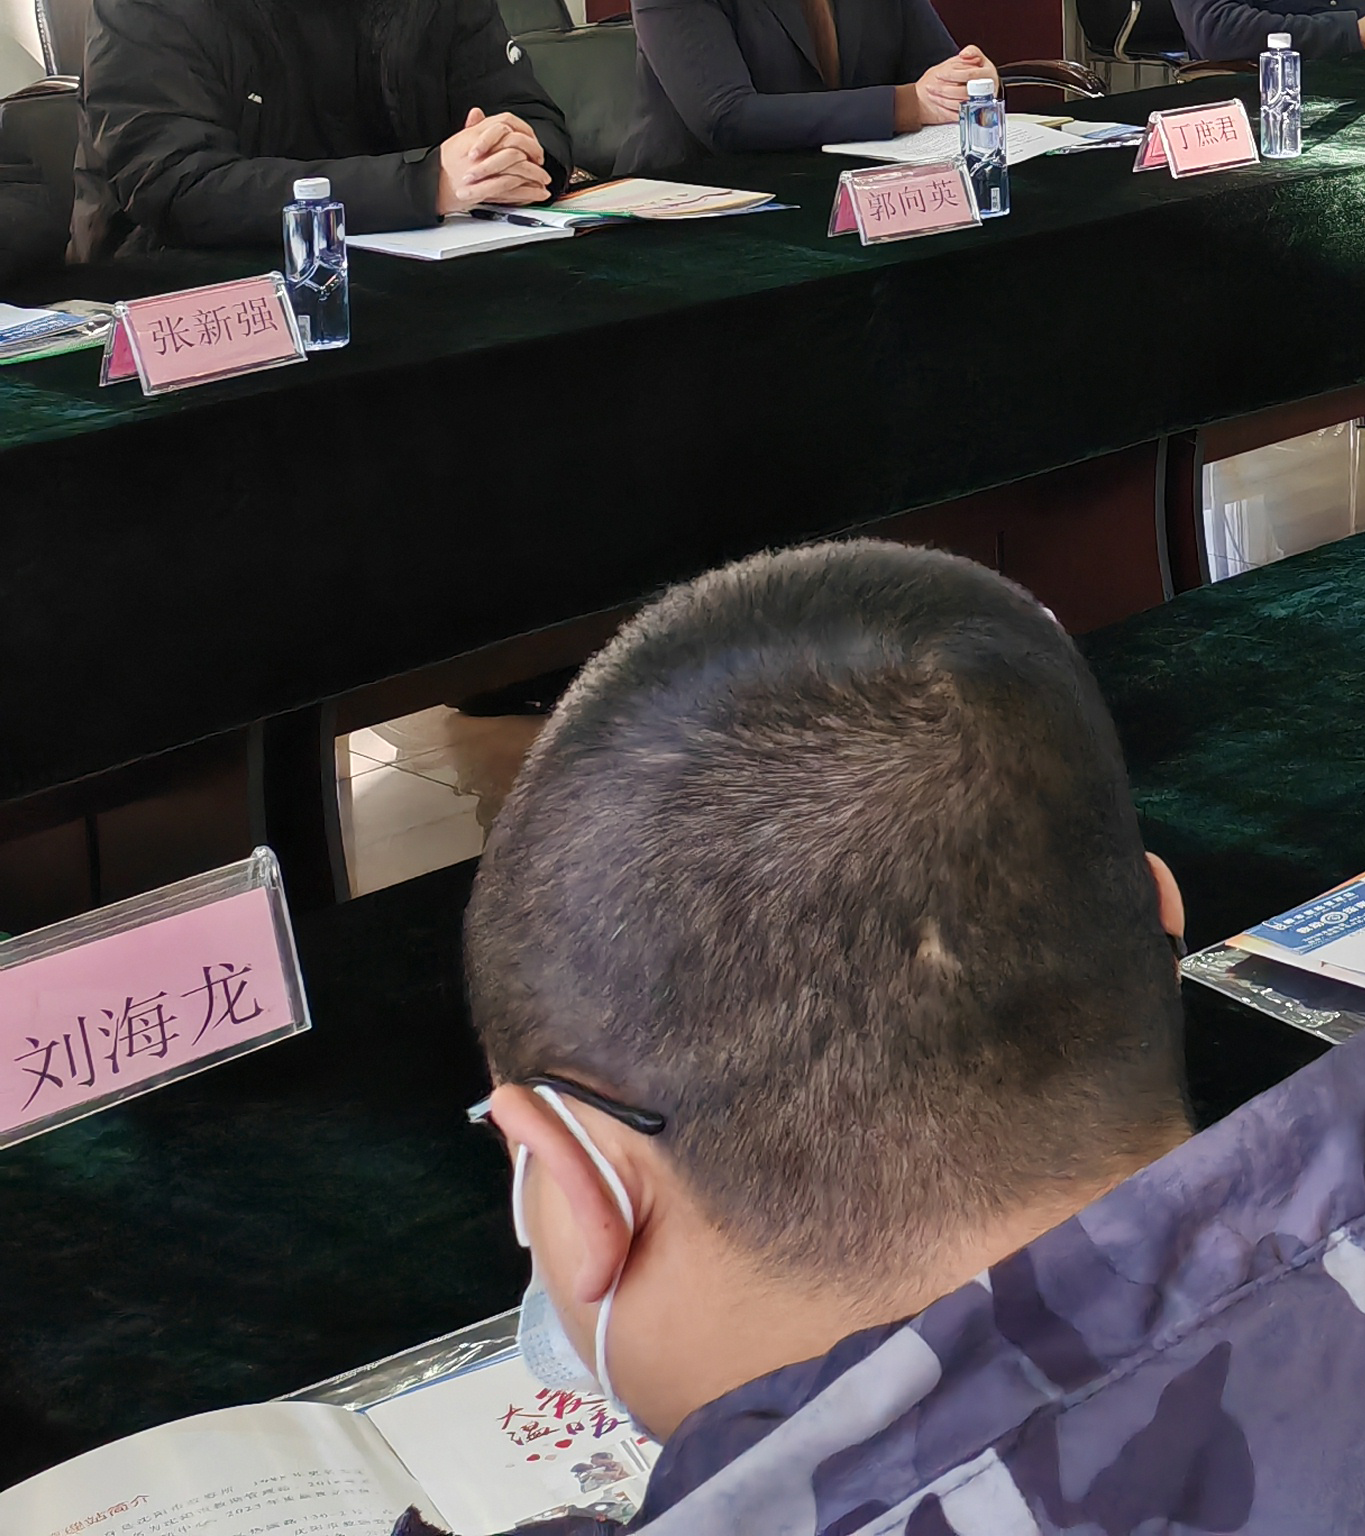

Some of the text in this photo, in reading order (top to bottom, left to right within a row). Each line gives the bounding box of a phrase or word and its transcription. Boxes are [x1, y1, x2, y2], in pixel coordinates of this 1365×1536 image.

[1171, 116, 1238, 150] 丁庶君
[866, 179, 960, 221] 郭向英
[148, 297, 278, 356] 张新强
[12, 963, 266, 1113] 刘海龙
